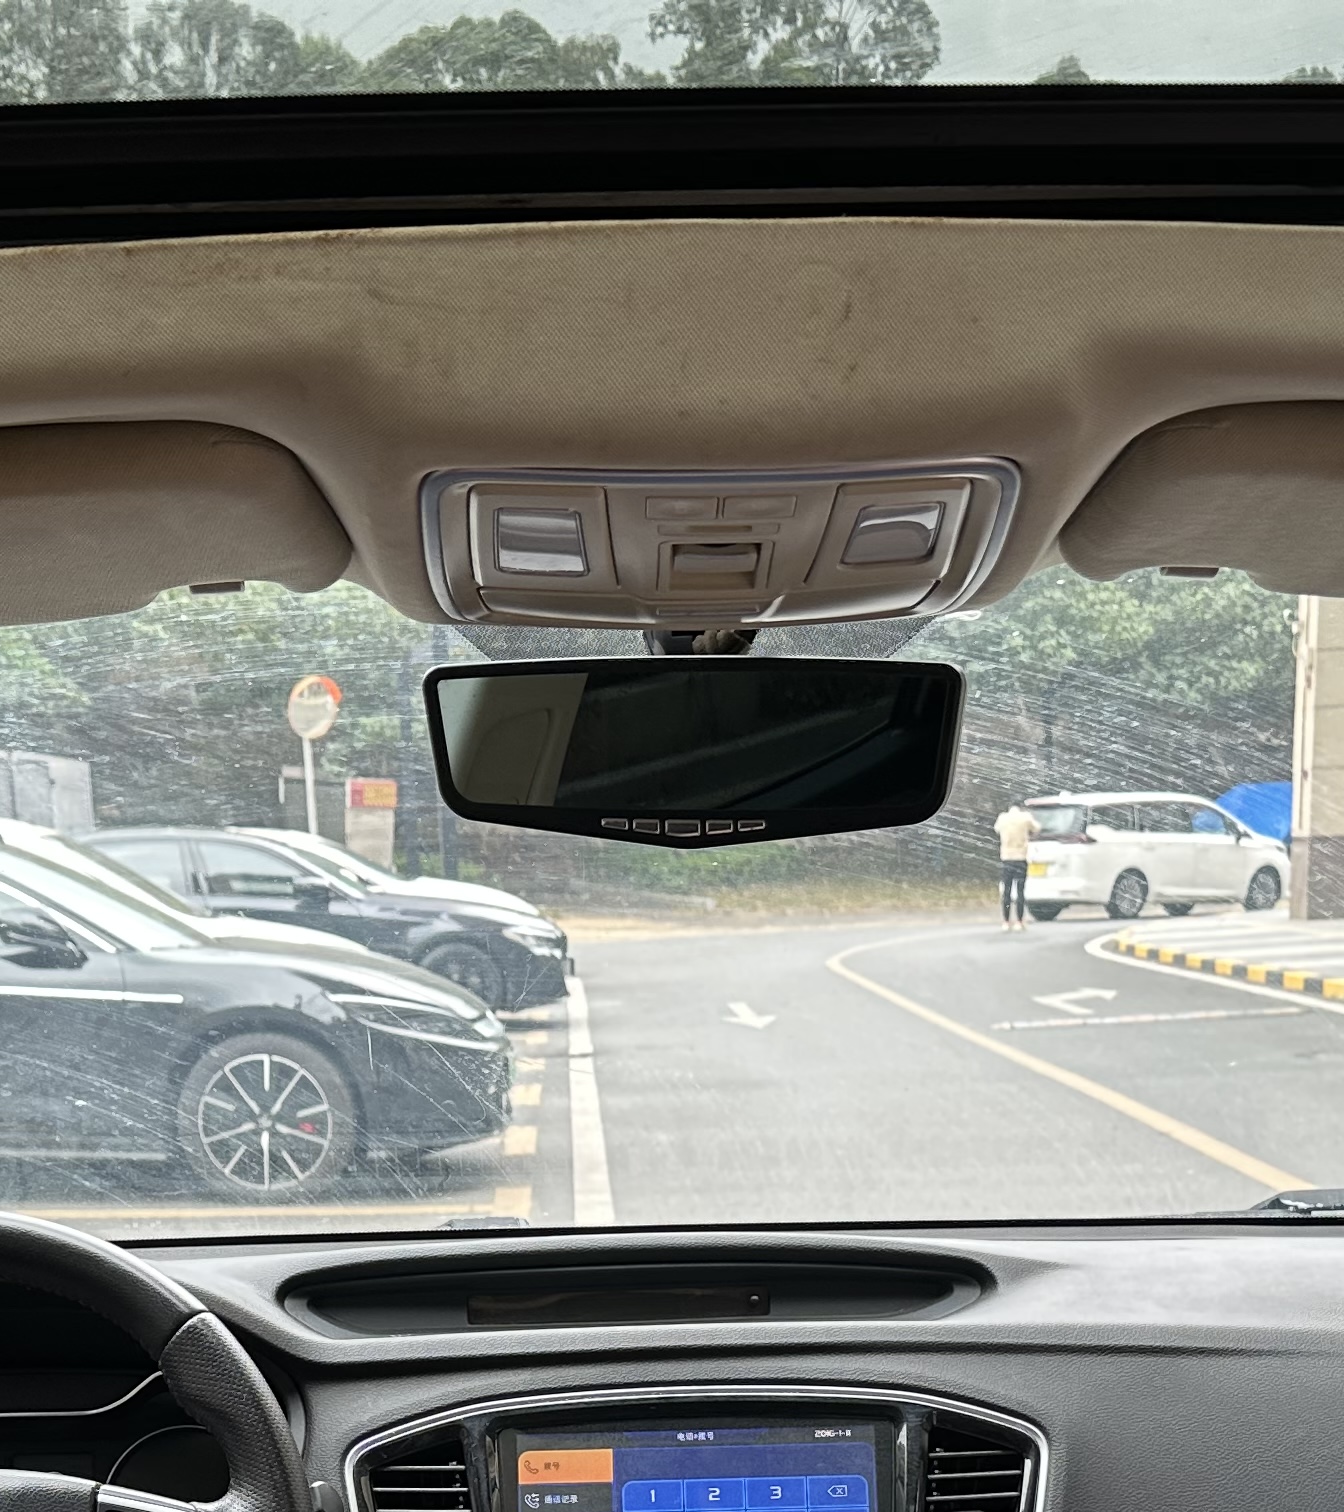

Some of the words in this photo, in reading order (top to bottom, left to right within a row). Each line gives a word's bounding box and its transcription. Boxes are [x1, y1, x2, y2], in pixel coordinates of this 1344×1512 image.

[649, 1489, 656, 1502] 1
[708, 1487, 721, 1501] 2
[769, 1486, 782, 1499] 3
